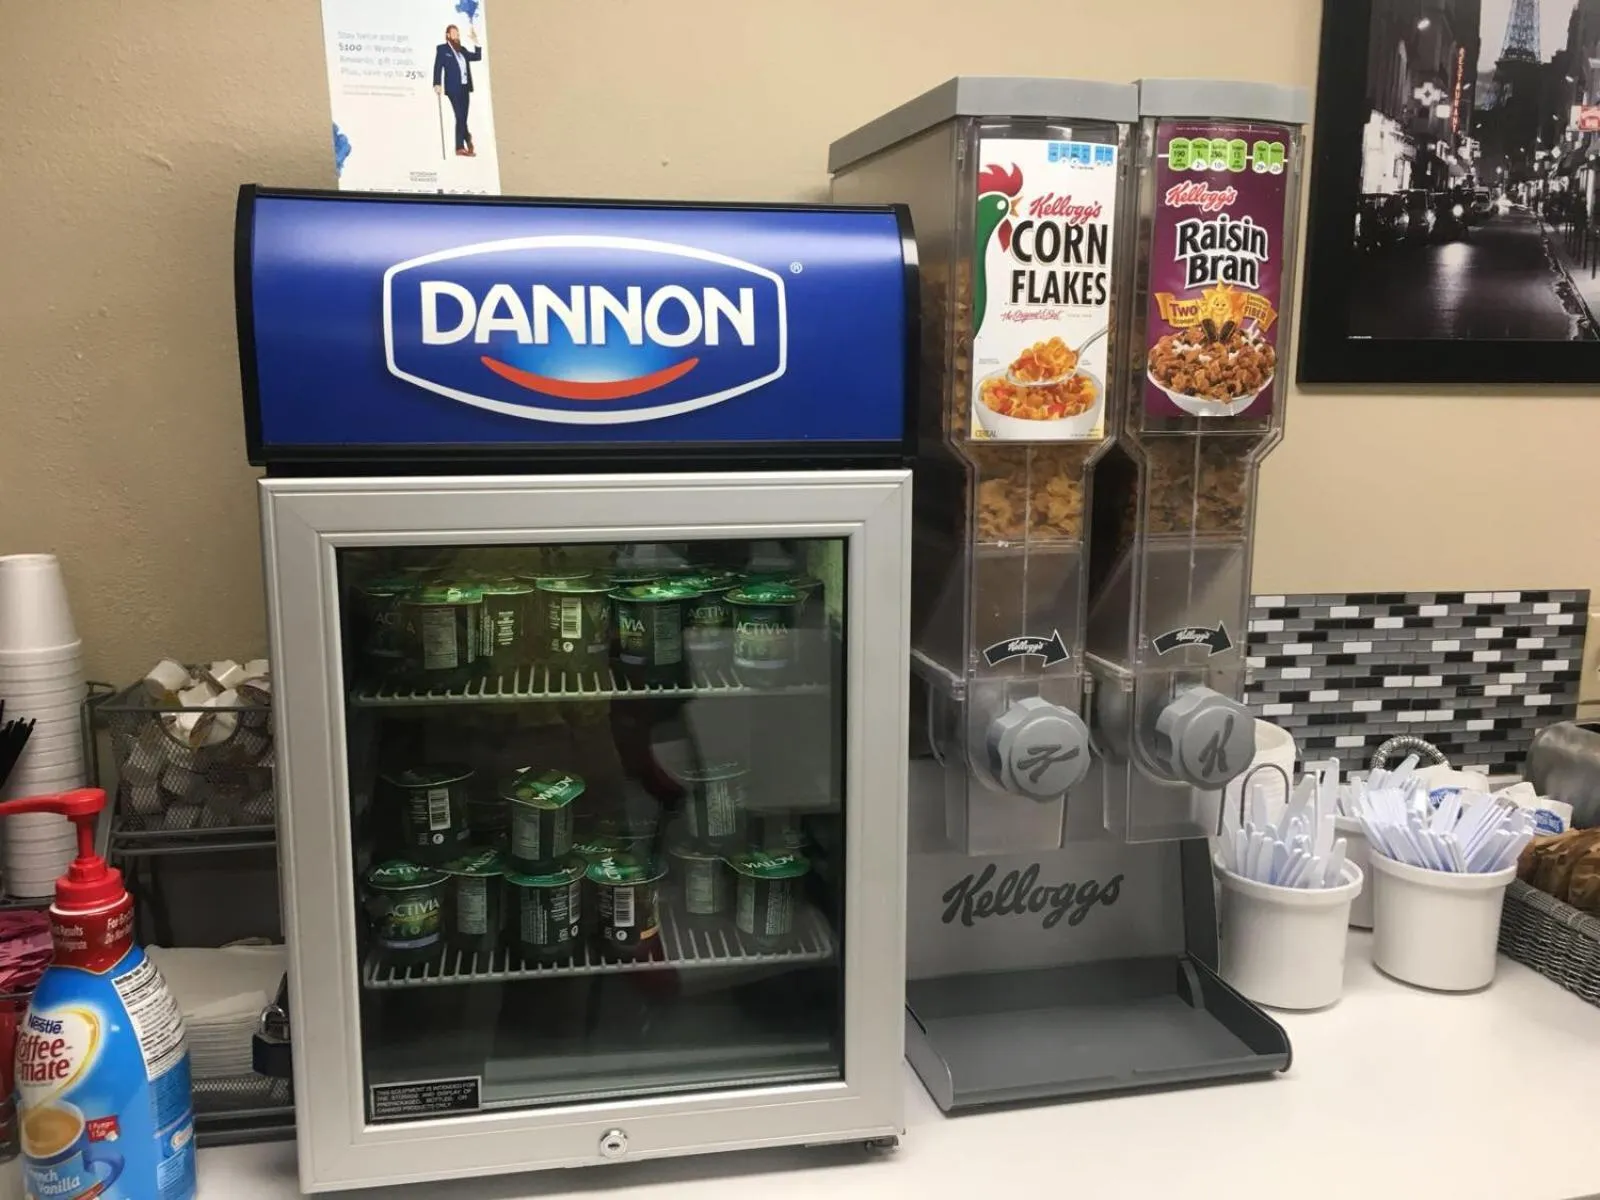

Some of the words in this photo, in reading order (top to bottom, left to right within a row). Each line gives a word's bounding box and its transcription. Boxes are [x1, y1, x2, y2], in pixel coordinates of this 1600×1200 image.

[1029, 192, 1102, 225] Kellogg's
[1166, 181, 1237, 211] Kellogg's
[1011, 219, 1108, 265] CORN
[1178, 214, 1267, 258] Raisin
[1011, 269, 1107, 305] FLAKES
[1187, 254, 1257, 287] Bran
[420, 280, 755, 348] DANNON
[736, 621, 788, 636] ACTIVIA
[21, 1059, 69, 1081] mate
